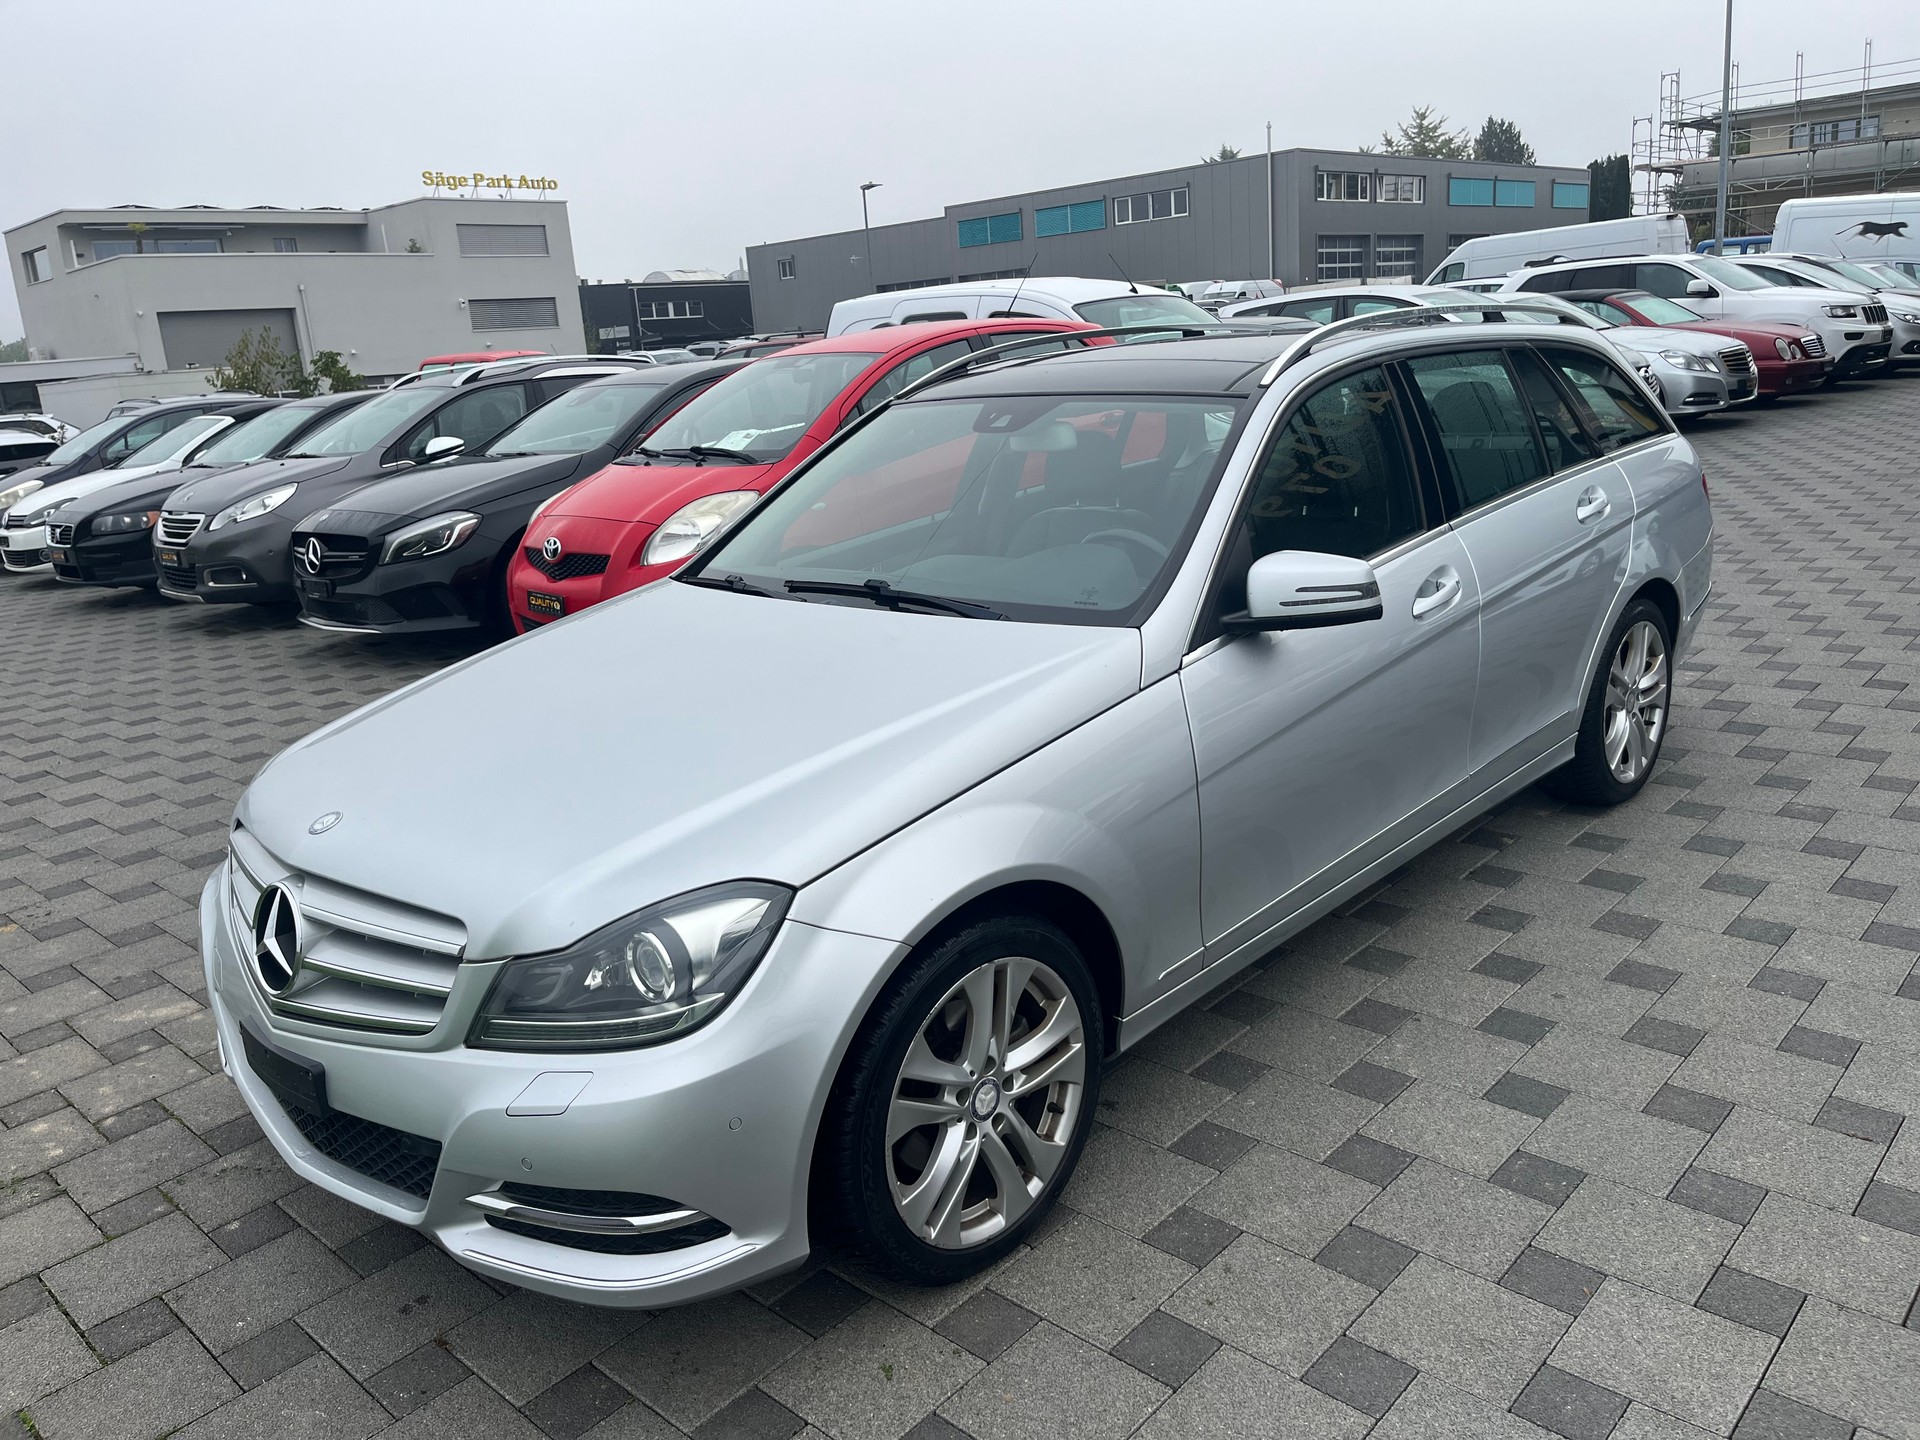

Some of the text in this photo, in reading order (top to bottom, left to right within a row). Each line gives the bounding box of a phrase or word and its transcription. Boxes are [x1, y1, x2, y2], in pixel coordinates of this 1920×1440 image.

[422, 171, 558, 190] Säge Park Auto
